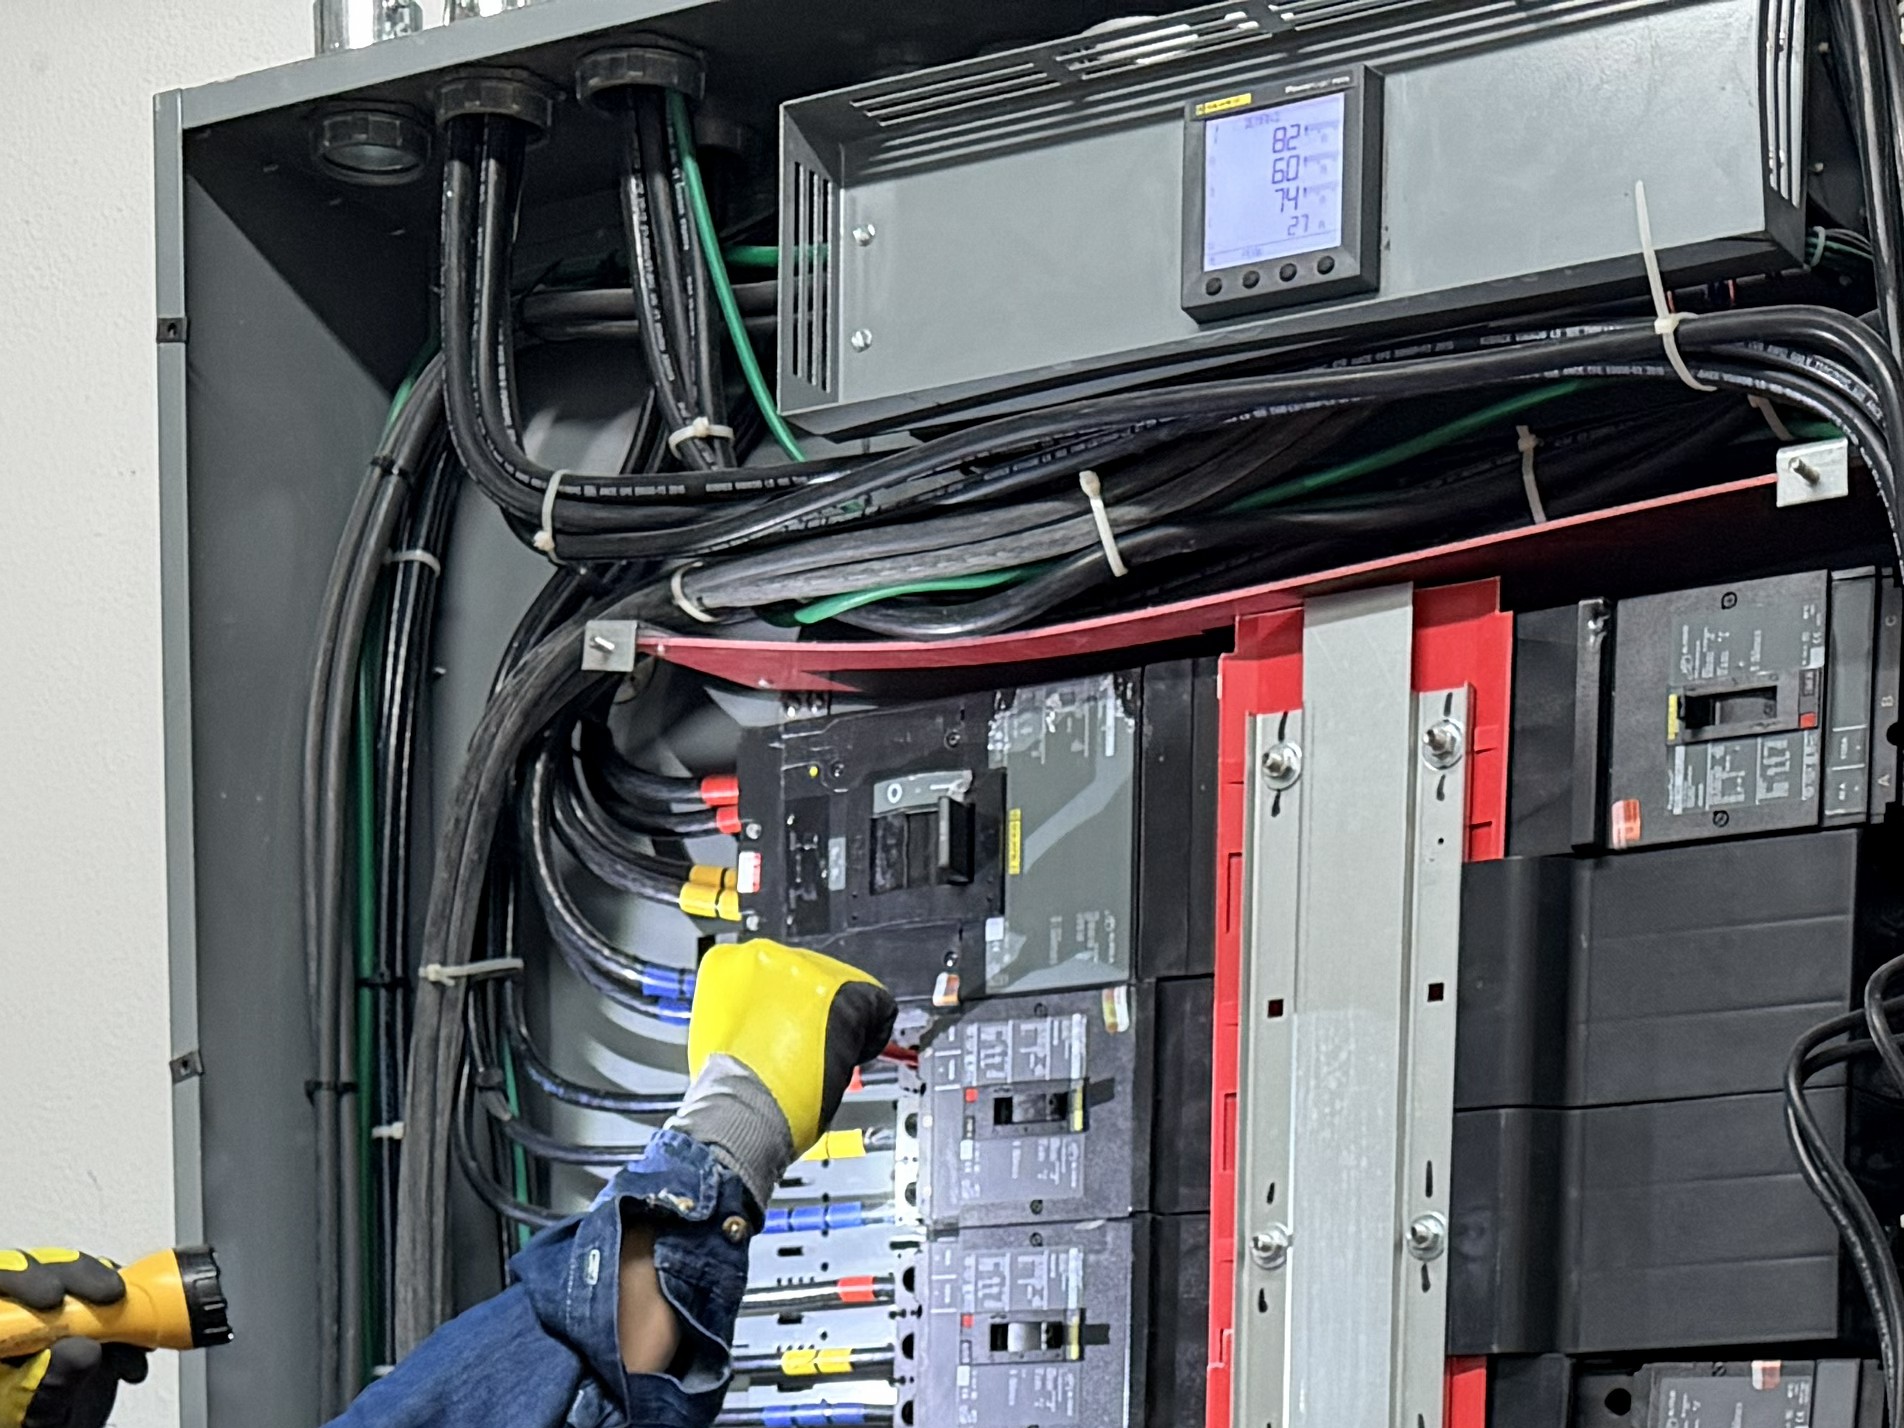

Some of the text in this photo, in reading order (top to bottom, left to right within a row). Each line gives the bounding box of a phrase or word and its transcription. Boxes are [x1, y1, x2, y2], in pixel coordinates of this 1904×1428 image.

[1272, 124, 1300, 153] 82
[1271, 155, 1300, 184] 60
[1274, 186, 1300, 213] 74
[1881, 696, 1893, 707] B
[1877, 774, 1890, 786] A
